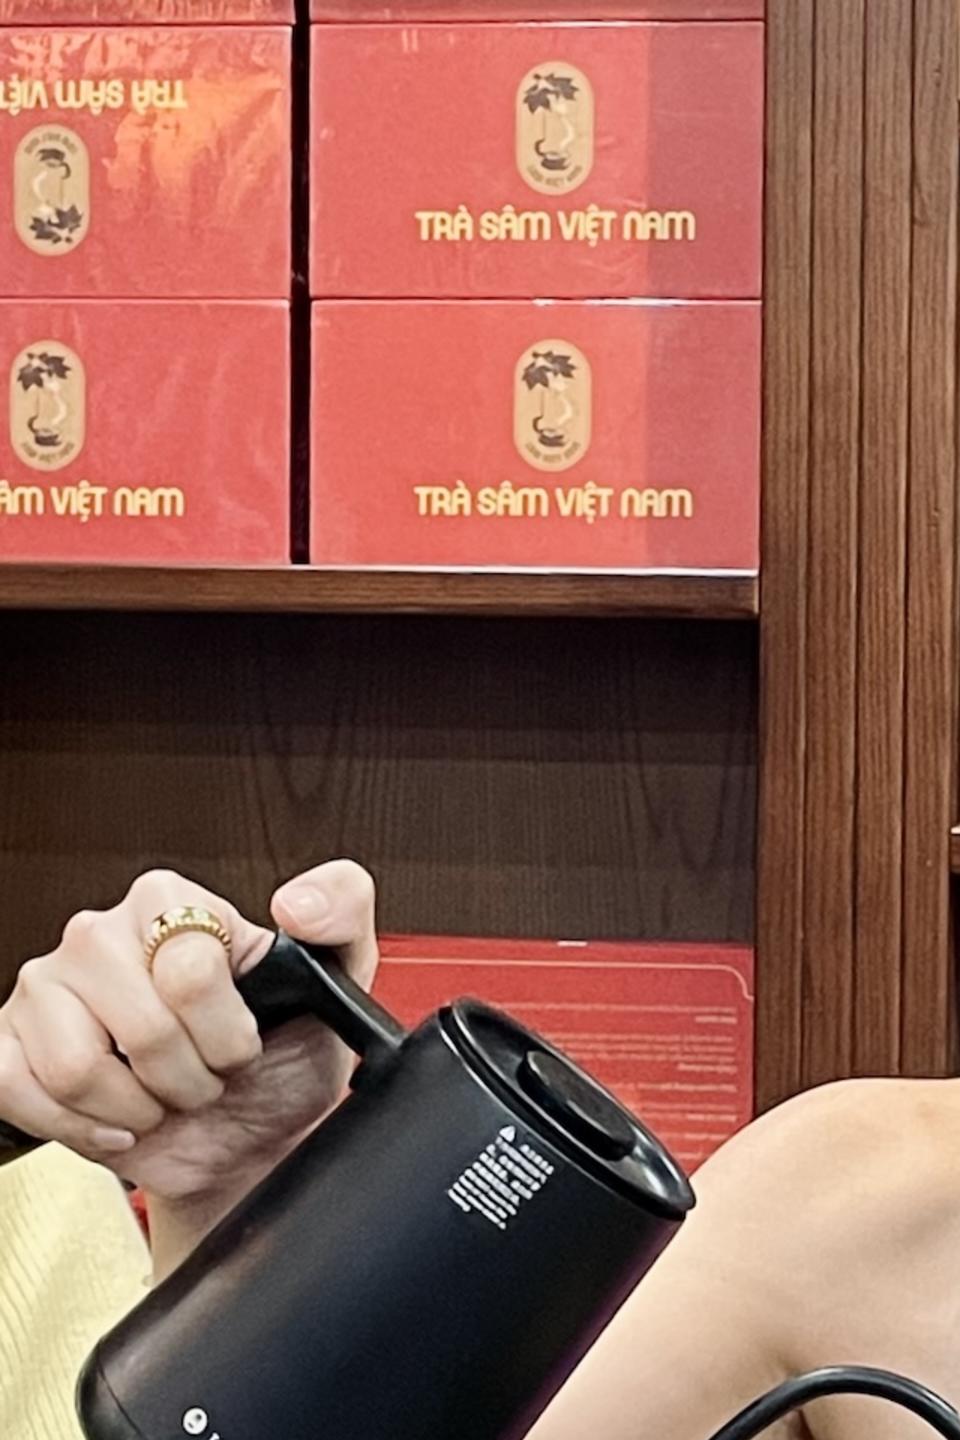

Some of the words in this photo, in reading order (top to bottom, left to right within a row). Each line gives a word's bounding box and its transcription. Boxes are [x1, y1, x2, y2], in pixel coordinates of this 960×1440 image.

[415, 204, 473, 241] TRÀ
[479, 204, 550, 241] SÂM
[557, 203, 617, 248] VIỆT
[623, 210, 696, 241] NAM
[0, 479, 44, 516] ÂM
[51, 480, 108, 523] VIỆT
[114, 486, 184, 517] NAM
[414, 480, 471, 517] TRÀ
[477, 480, 549, 517] SÂM
[555, 480, 614, 525] VIỆT
[620, 487, 693, 518] NAM
